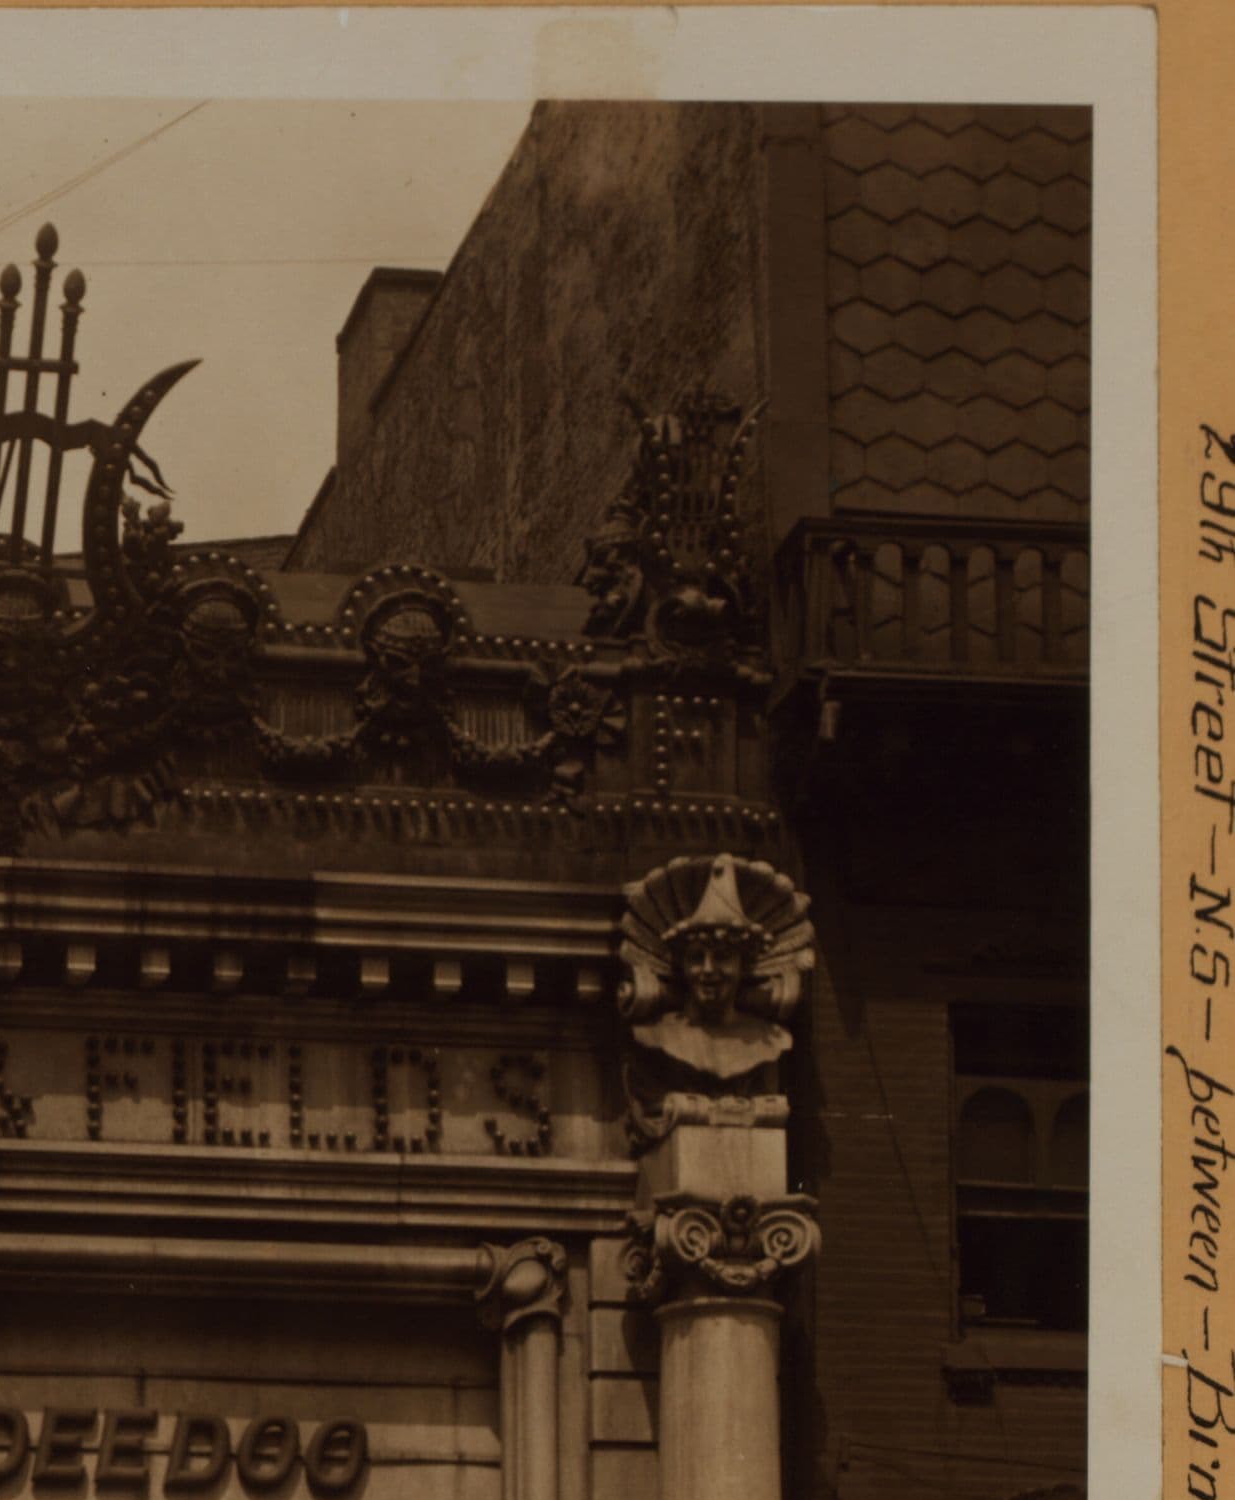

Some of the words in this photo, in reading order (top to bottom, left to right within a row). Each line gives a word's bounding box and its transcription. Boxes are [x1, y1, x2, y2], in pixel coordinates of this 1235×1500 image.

[1192, 594, 1234, 834] Street
[85, 1035, 552, 1155] FIELDS
[1165, 1044, 1234, 1293] between
